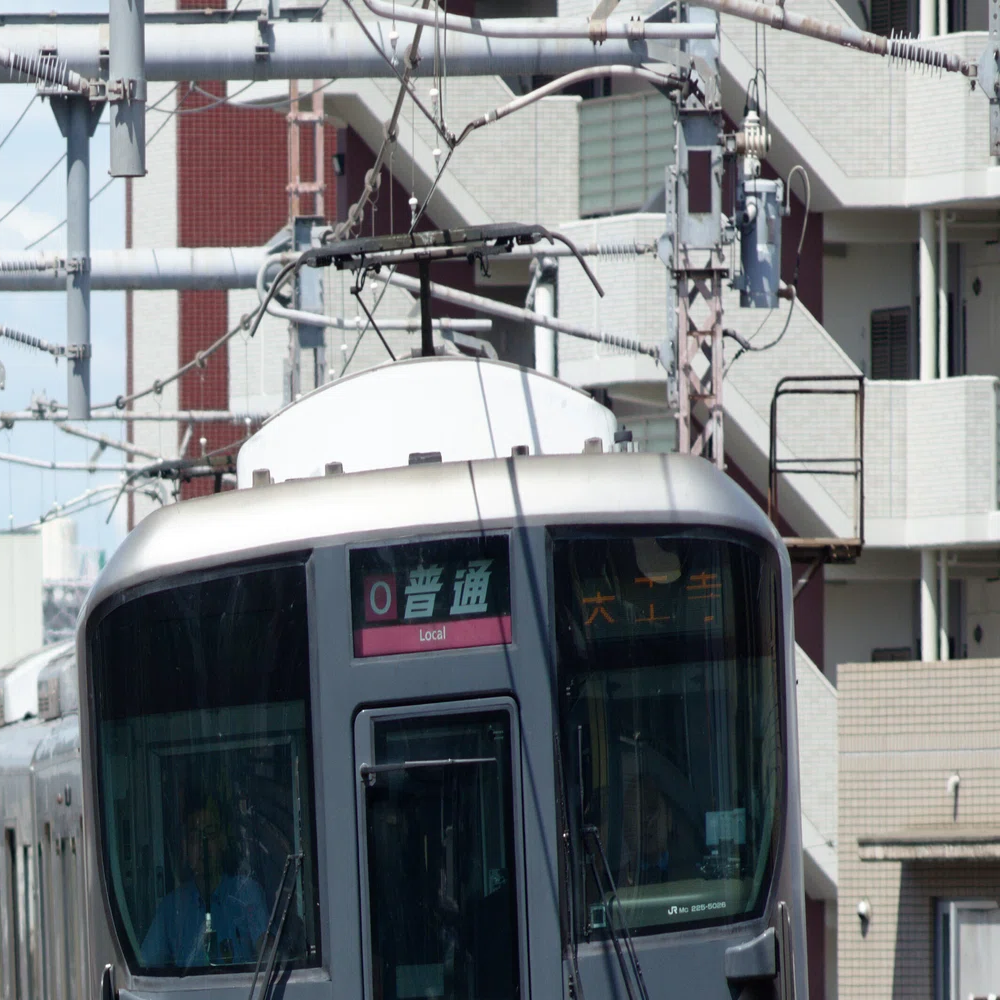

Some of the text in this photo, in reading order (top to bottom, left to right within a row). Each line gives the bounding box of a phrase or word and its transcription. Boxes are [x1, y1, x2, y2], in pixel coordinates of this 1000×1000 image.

[404, 558, 494, 619] 普通
[419, 625, 446, 642] Local
[667, 905, 678, 915] JR
[691, 901, 727, 912] 225-5026
